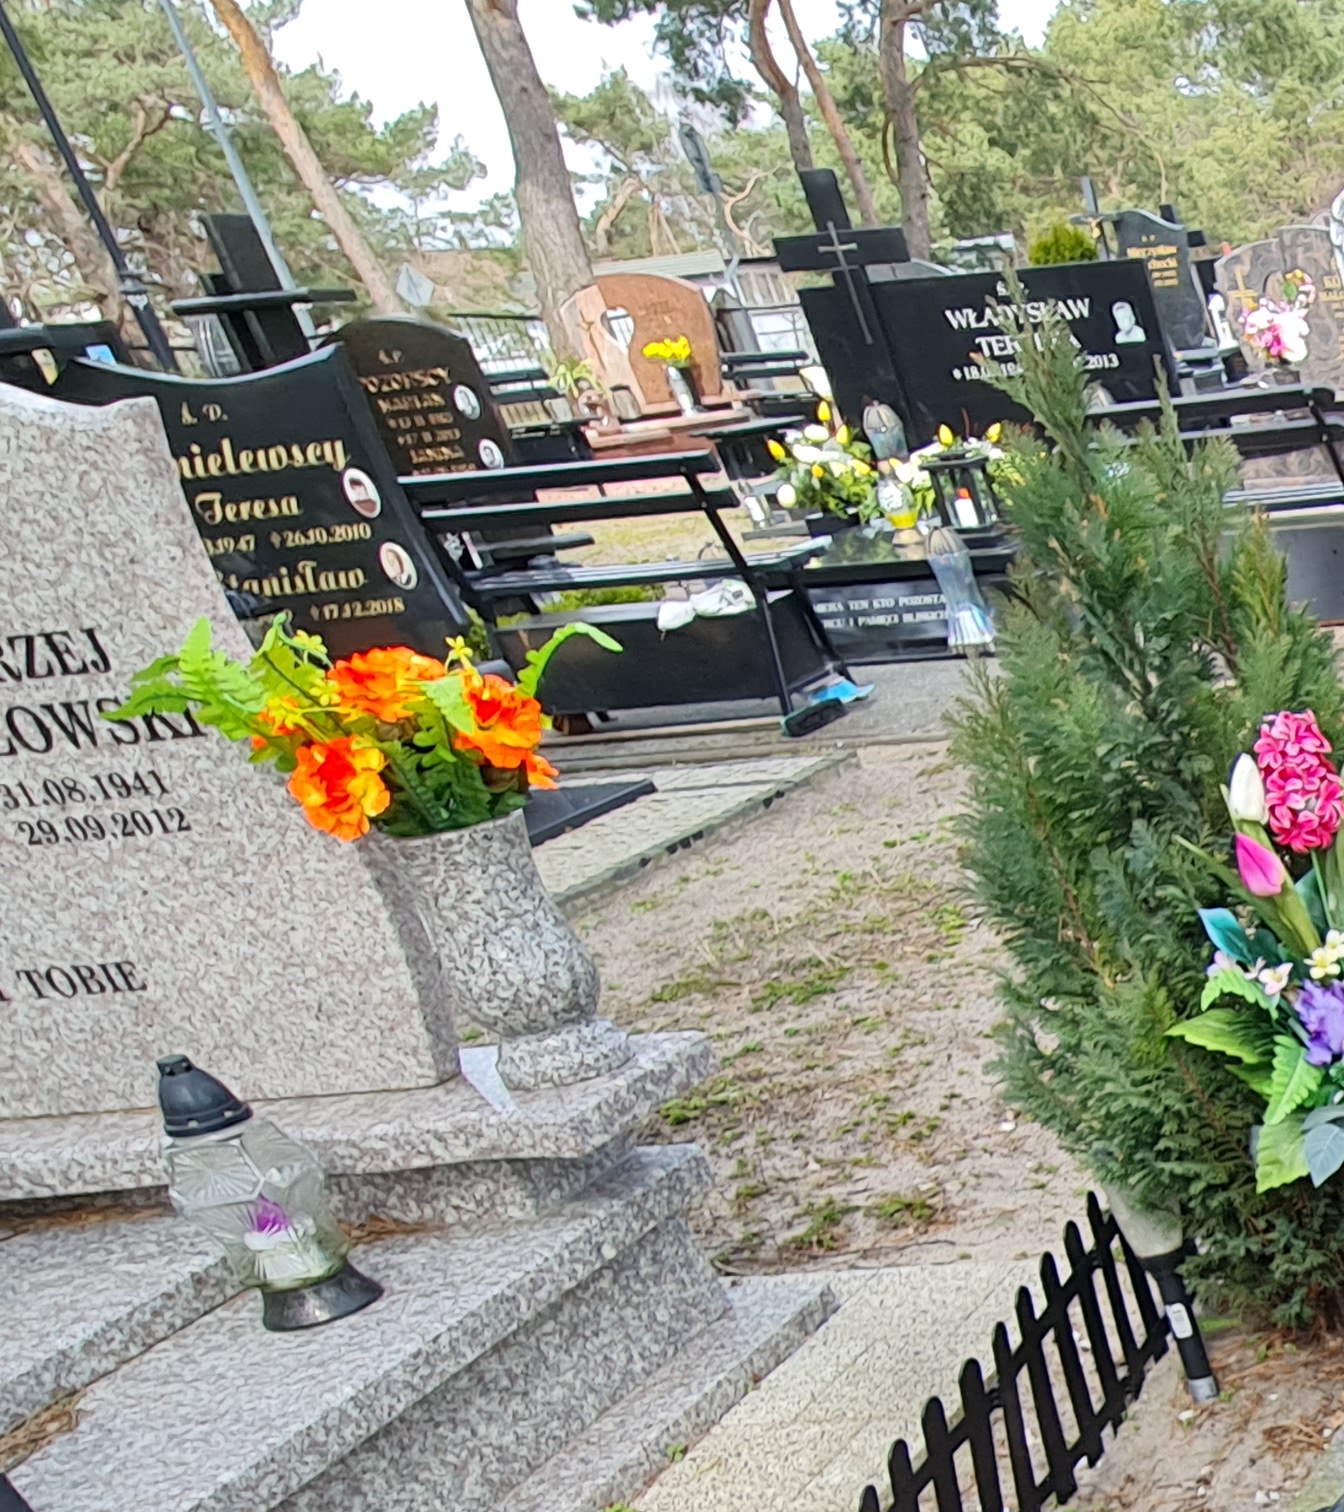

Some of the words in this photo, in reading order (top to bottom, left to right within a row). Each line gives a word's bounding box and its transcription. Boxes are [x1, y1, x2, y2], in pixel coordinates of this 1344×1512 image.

[195, 491, 303, 526] Teresa
[17, 806, 193, 846] 29.09.2012
[16, 961, 147, 1000] TOBIE
